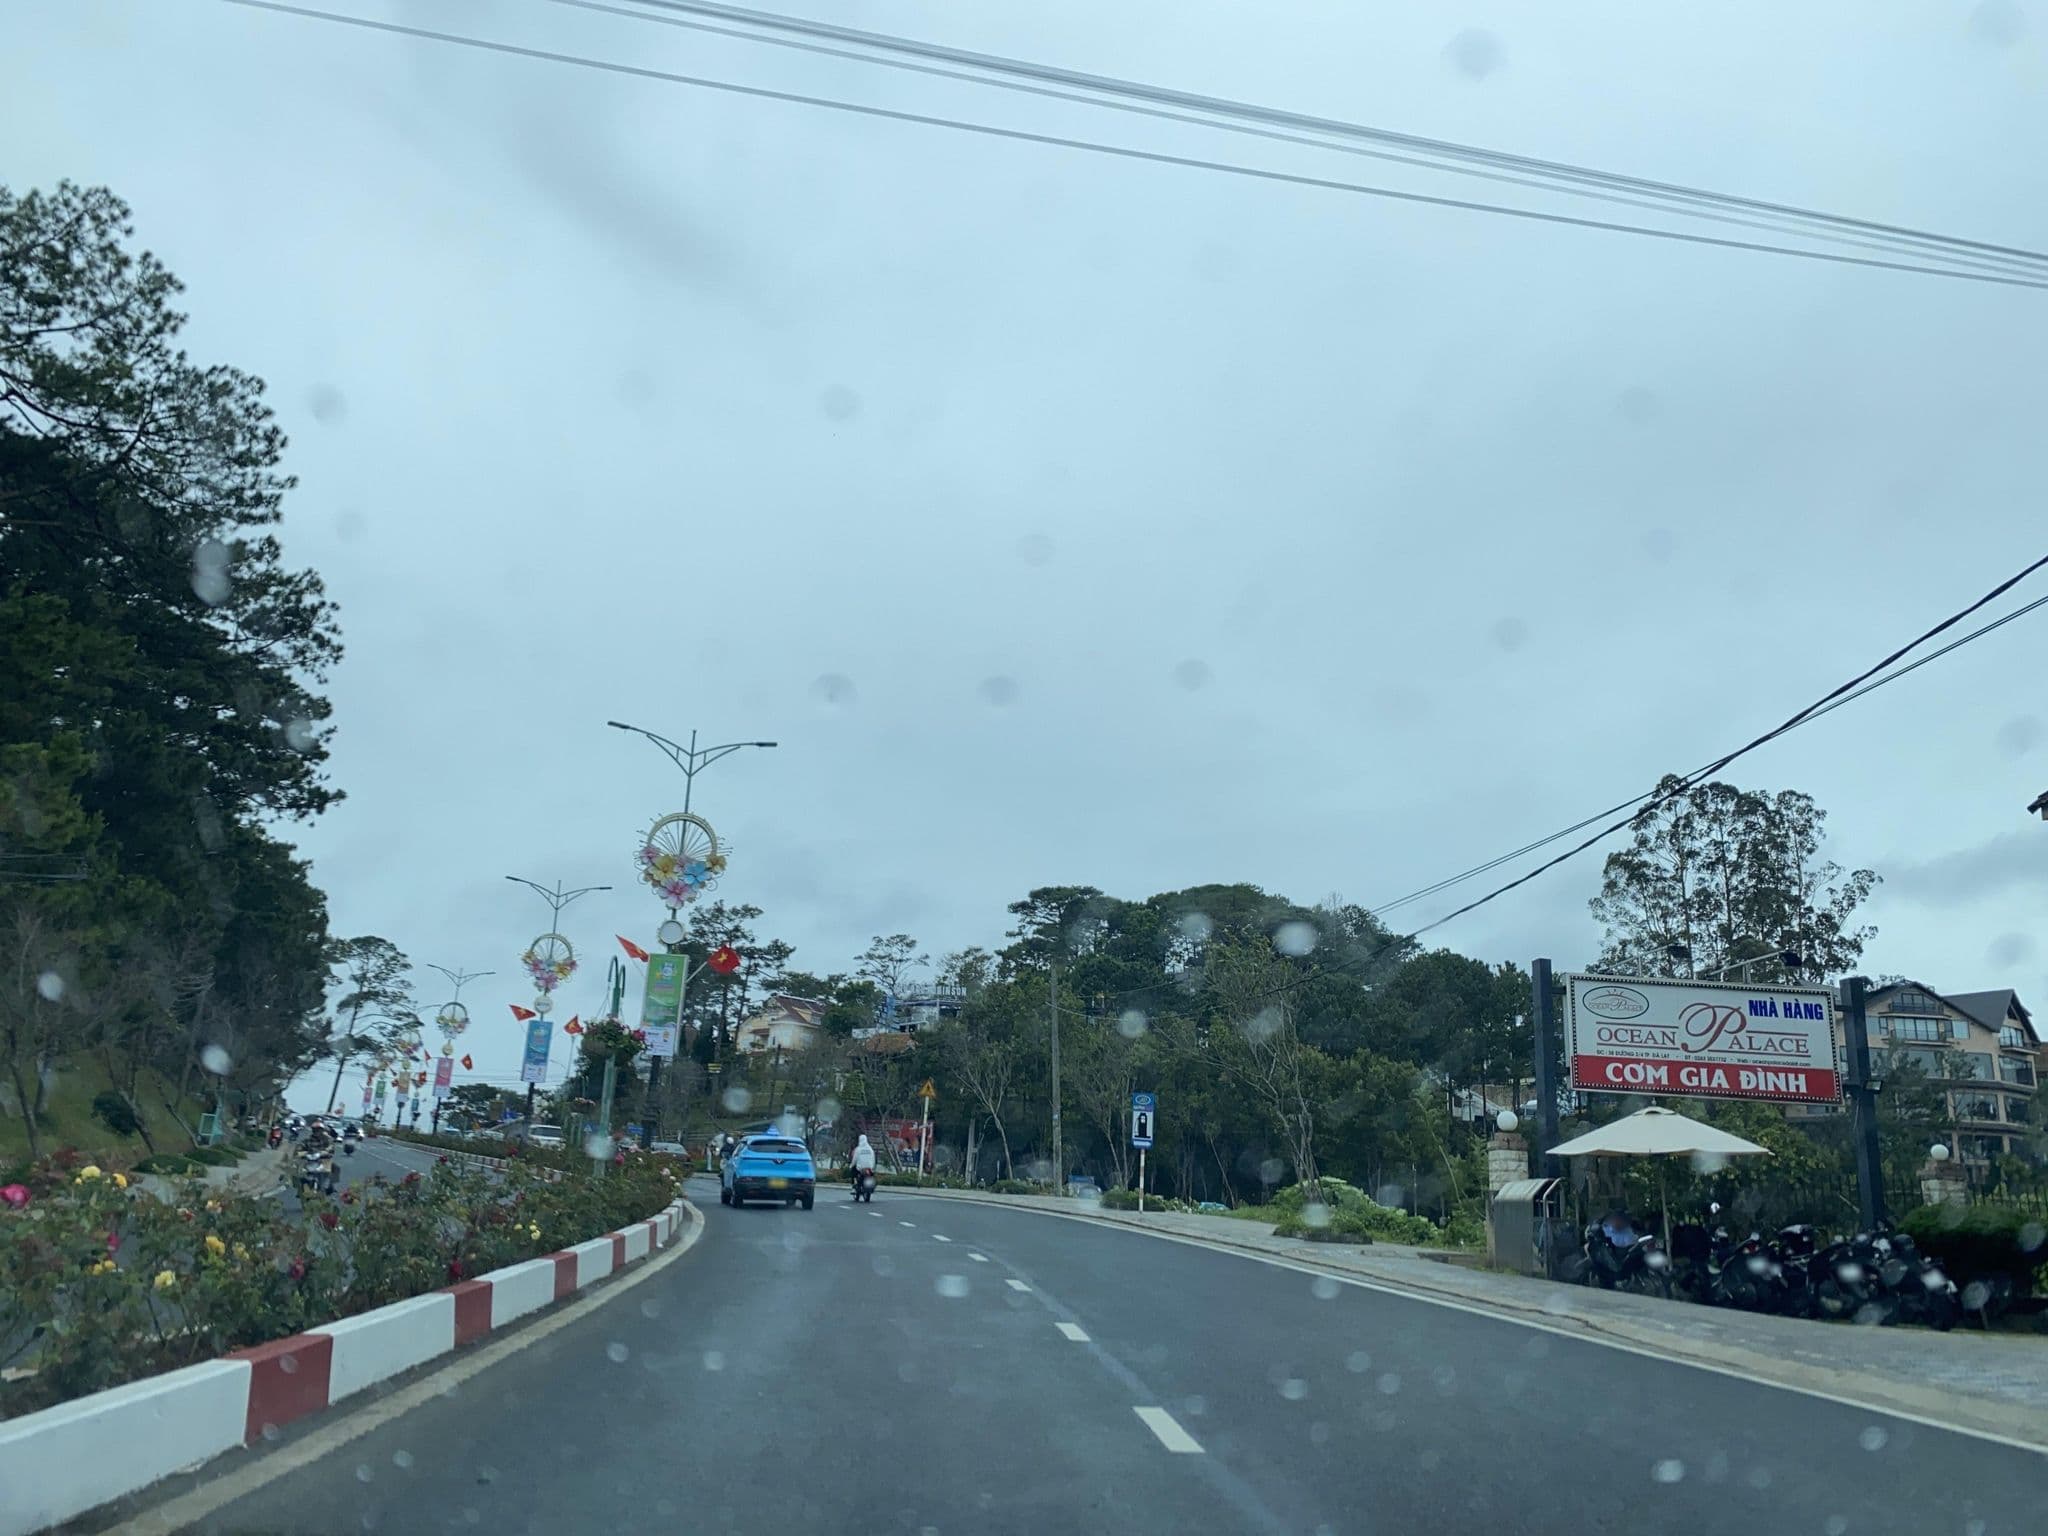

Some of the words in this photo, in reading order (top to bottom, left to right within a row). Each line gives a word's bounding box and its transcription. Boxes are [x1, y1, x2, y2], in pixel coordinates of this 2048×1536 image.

[1748, 997, 1779, 1018] NHÀ
[1783, 998, 1824, 1021] HÀNG
[1597, 1027, 1677, 1046] OCEAN
[1679, 1002, 1809, 1054] PALACE
[1605, 1062, 1669, 1085] CƠM
[1680, 1067, 1730, 1089] GIA
[1739, 1067, 1807, 1093] ĐÌNH
